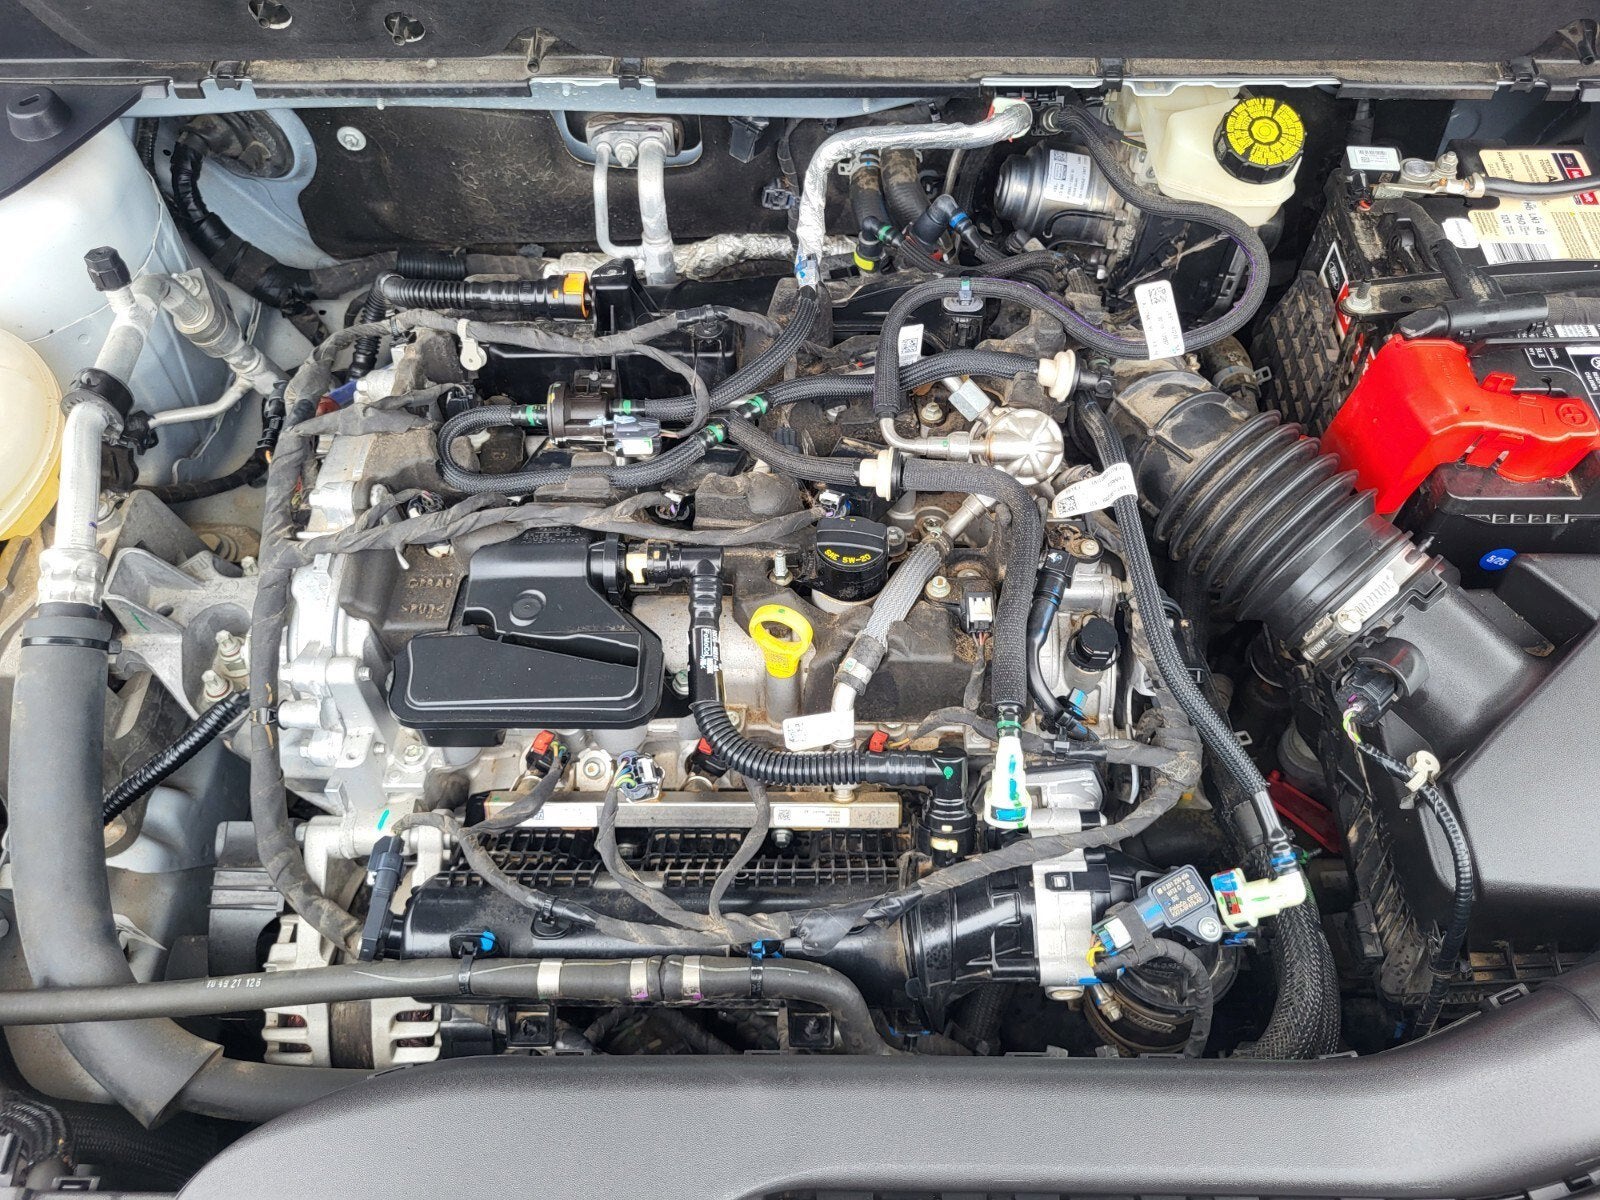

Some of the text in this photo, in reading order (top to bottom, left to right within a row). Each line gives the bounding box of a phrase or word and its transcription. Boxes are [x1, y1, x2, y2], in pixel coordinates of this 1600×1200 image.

[824, 549, 872, 564] SAE 5W-20
[1486, 554, 1509, 566] 5/25
